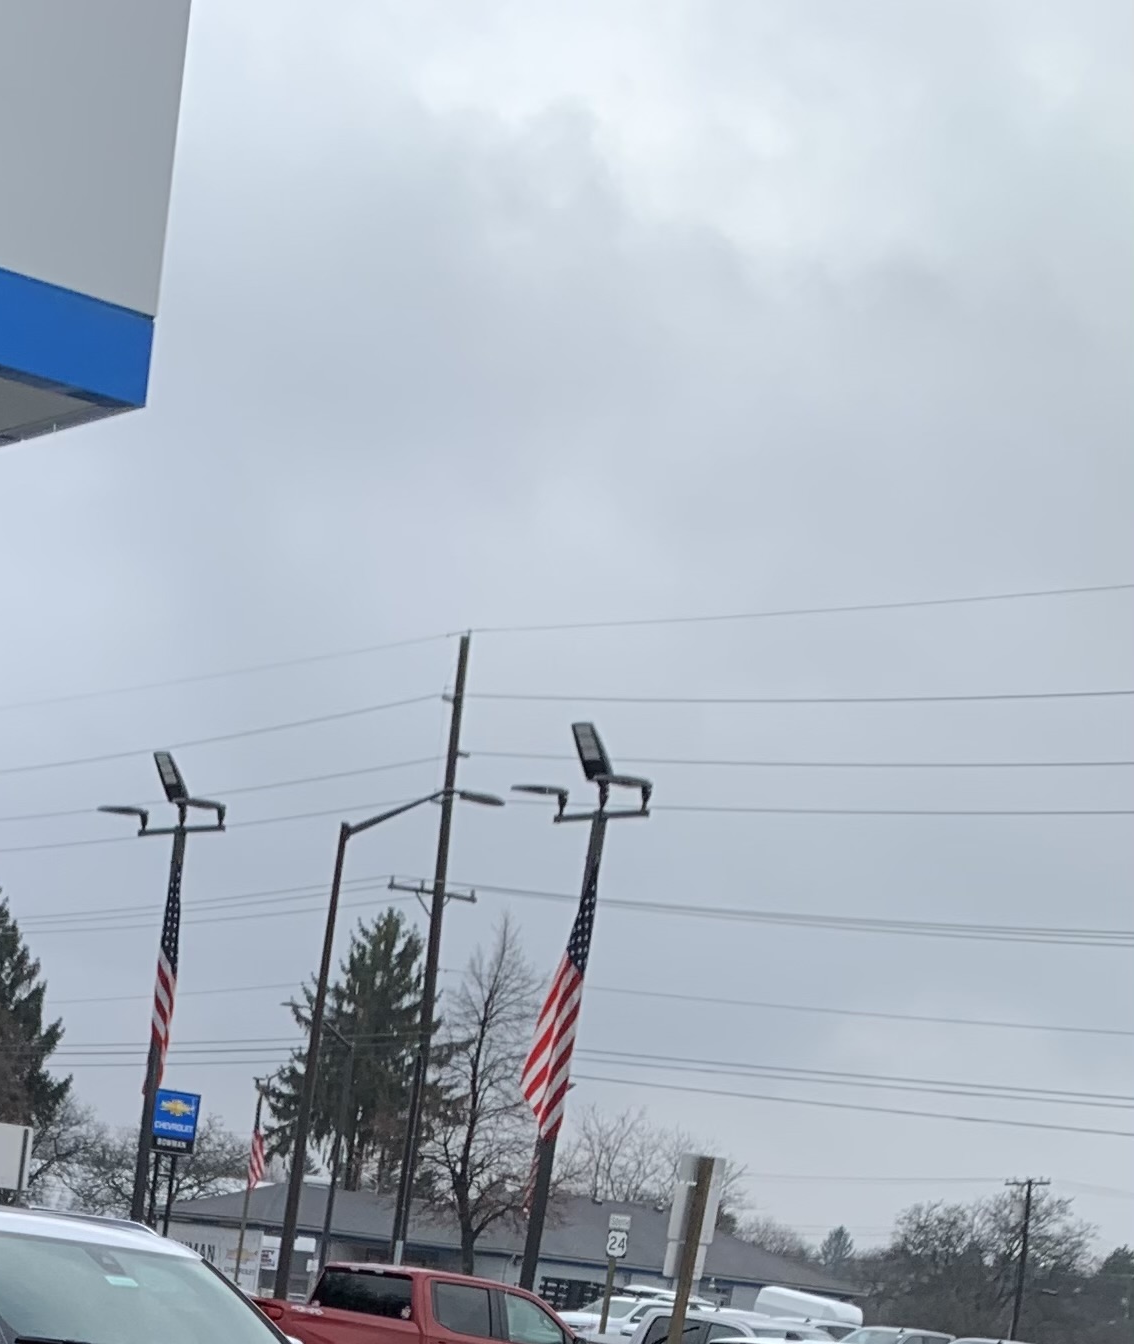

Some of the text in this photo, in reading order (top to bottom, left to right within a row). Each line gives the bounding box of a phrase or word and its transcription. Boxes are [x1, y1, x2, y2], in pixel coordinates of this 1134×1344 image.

[154, 1121, 194, 1133] CHEVROLET
[156, 1137, 187, 1149] BOWMAN
[608, 1235, 625, 1251] 24
